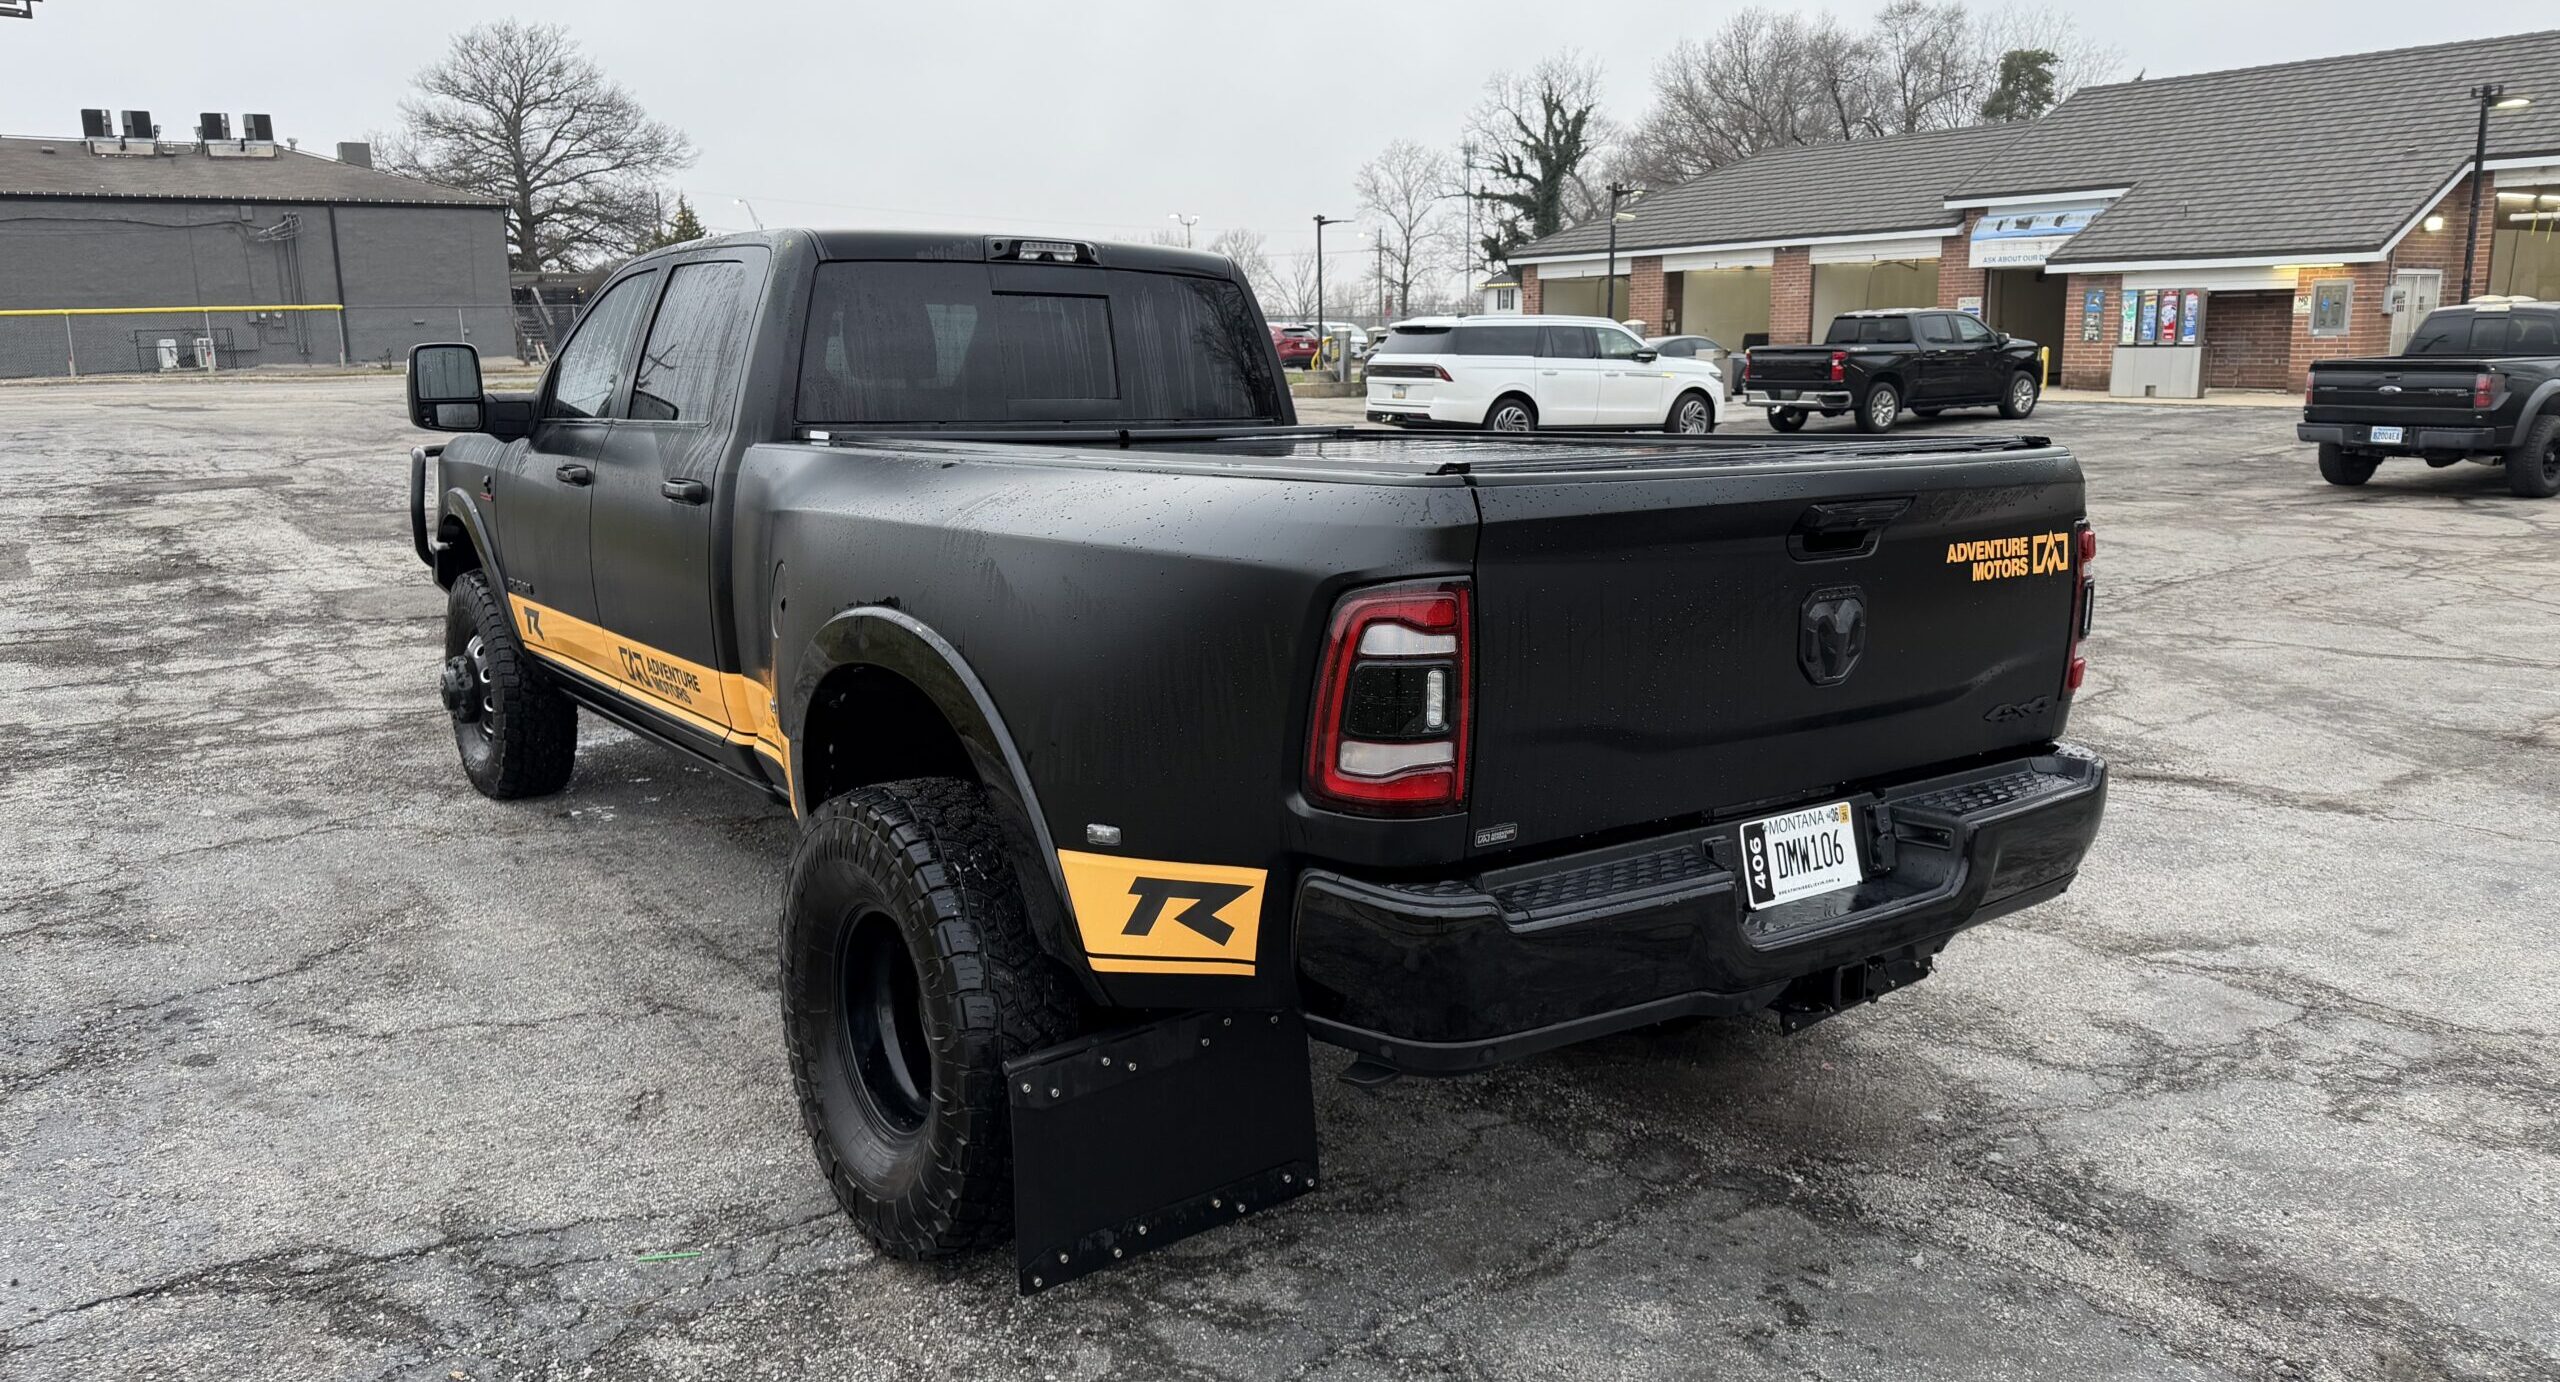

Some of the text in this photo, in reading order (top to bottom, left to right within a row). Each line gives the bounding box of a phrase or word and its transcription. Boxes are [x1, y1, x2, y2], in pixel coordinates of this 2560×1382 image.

[1998, 255, 2021, 263] ABOUT
[2022, 254, 2038, 262] OUR
[1946, 537, 2029, 563] ADVENTURE
[1972, 557, 2029, 581] MOTORS
[646, 656, 701, 693] ADVENTURE
[650, 674, 692, 704] MOTORS
[1768, 810, 1825, 835] MONTANA
[1750, 837, 1767, 889] 406
[1774, 829, 1845, 879] DMW106
